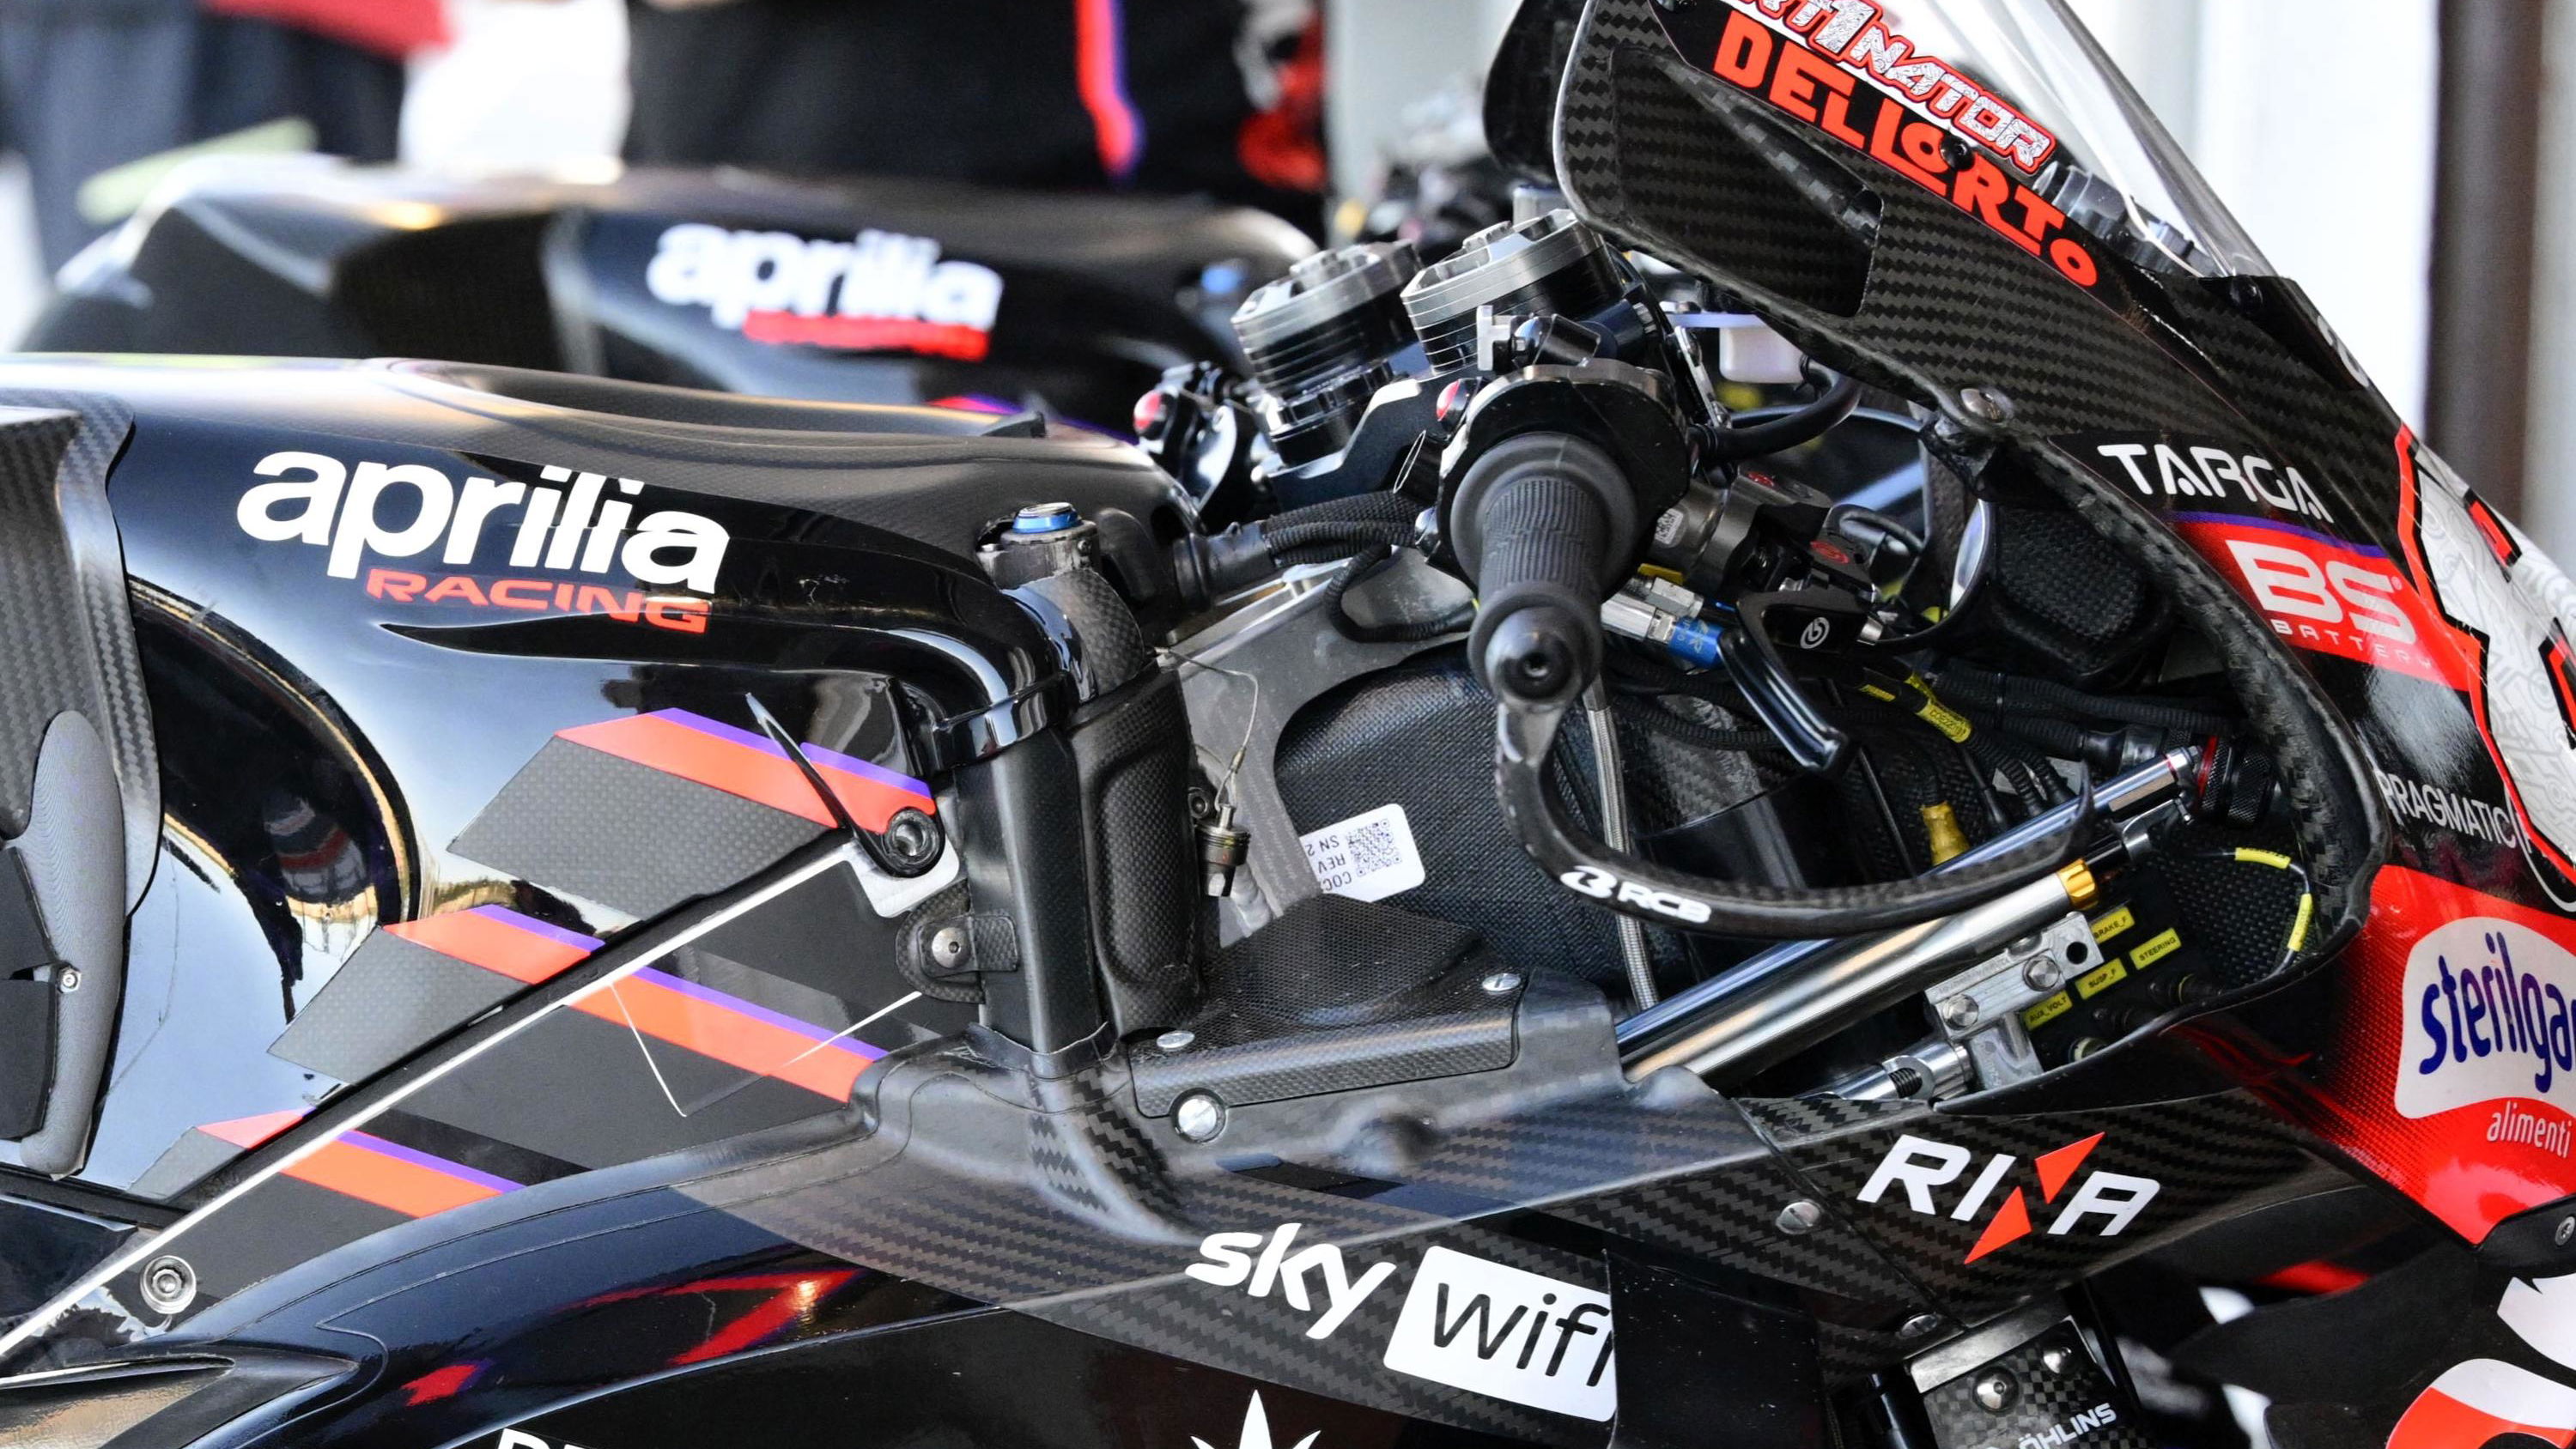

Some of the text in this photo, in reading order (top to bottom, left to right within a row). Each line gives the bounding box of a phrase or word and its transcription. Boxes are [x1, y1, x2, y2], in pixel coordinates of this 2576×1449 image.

[2098, 444, 2333, 523] TARGA
[237, 452, 730, 593] aprilia
[366, 569, 711, 634] RACING
[2226, 540, 2416, 645] BS
[2270, 619, 2432, 670] BATTERY
[2374, 769, 2516, 848] PRAGMATIC
[1317, 854, 1345, 873] REV
[1319, 835, 1339, 852] SN
[2137, 936, 2178, 963] STEERING
[2486, 1100, 2573, 1159] alimenti
[1185, 1223, 1396, 1339] sky
